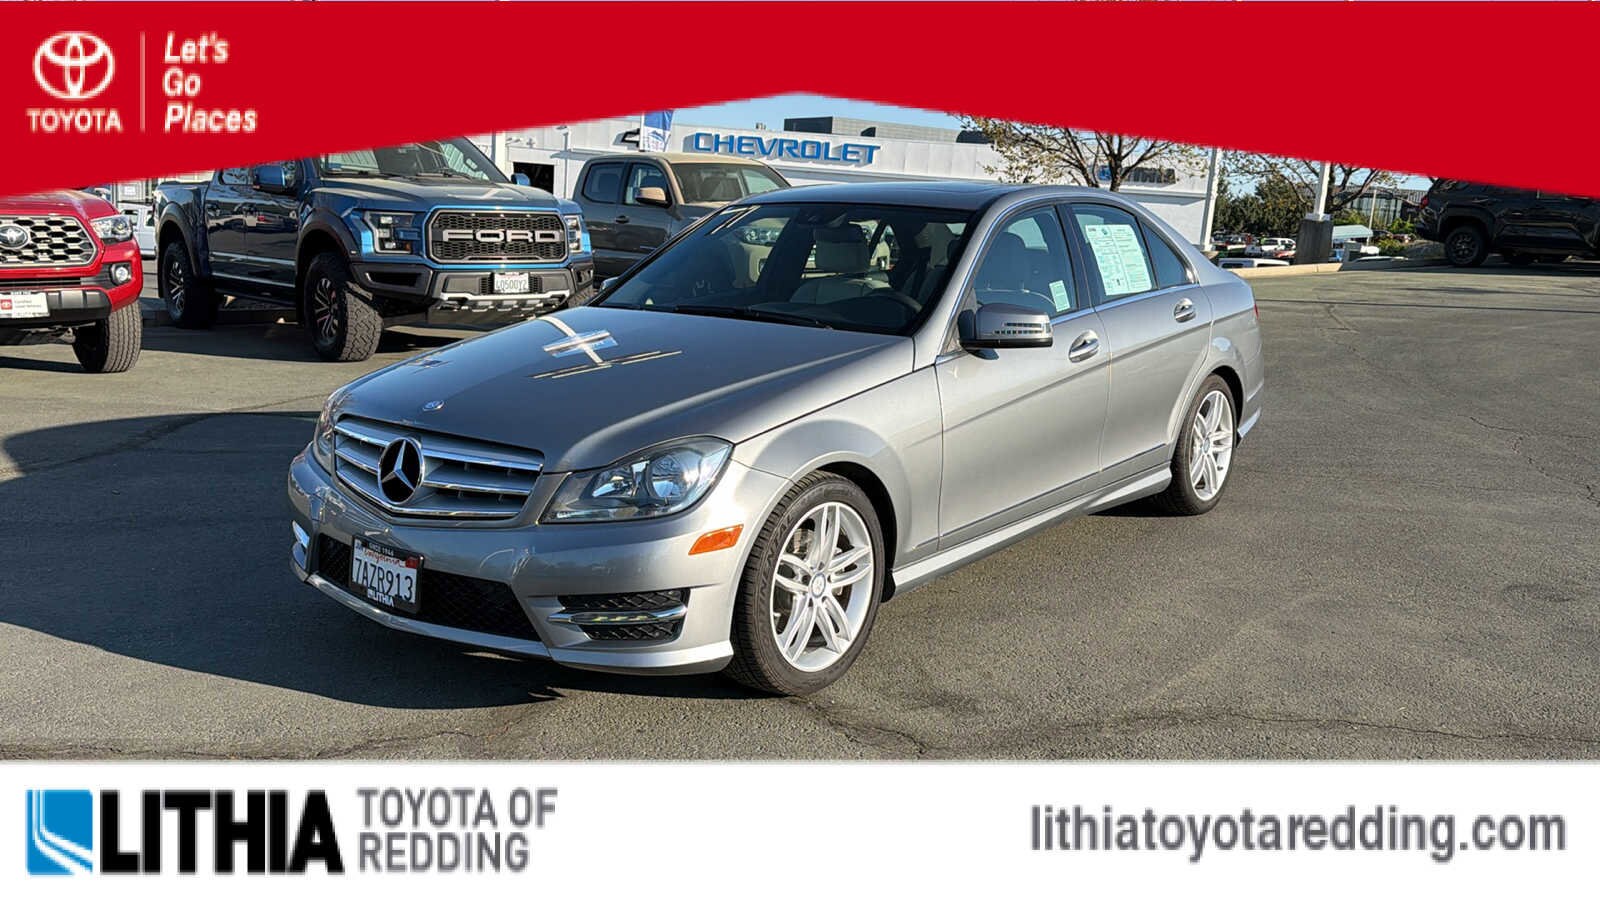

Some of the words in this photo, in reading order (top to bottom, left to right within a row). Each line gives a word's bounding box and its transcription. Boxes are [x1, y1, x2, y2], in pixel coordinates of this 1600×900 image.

[694, 132, 881, 164] CHEVROLET
[443, 229, 560, 242] FORD
[354, 557, 413, 601] 7AZR913
